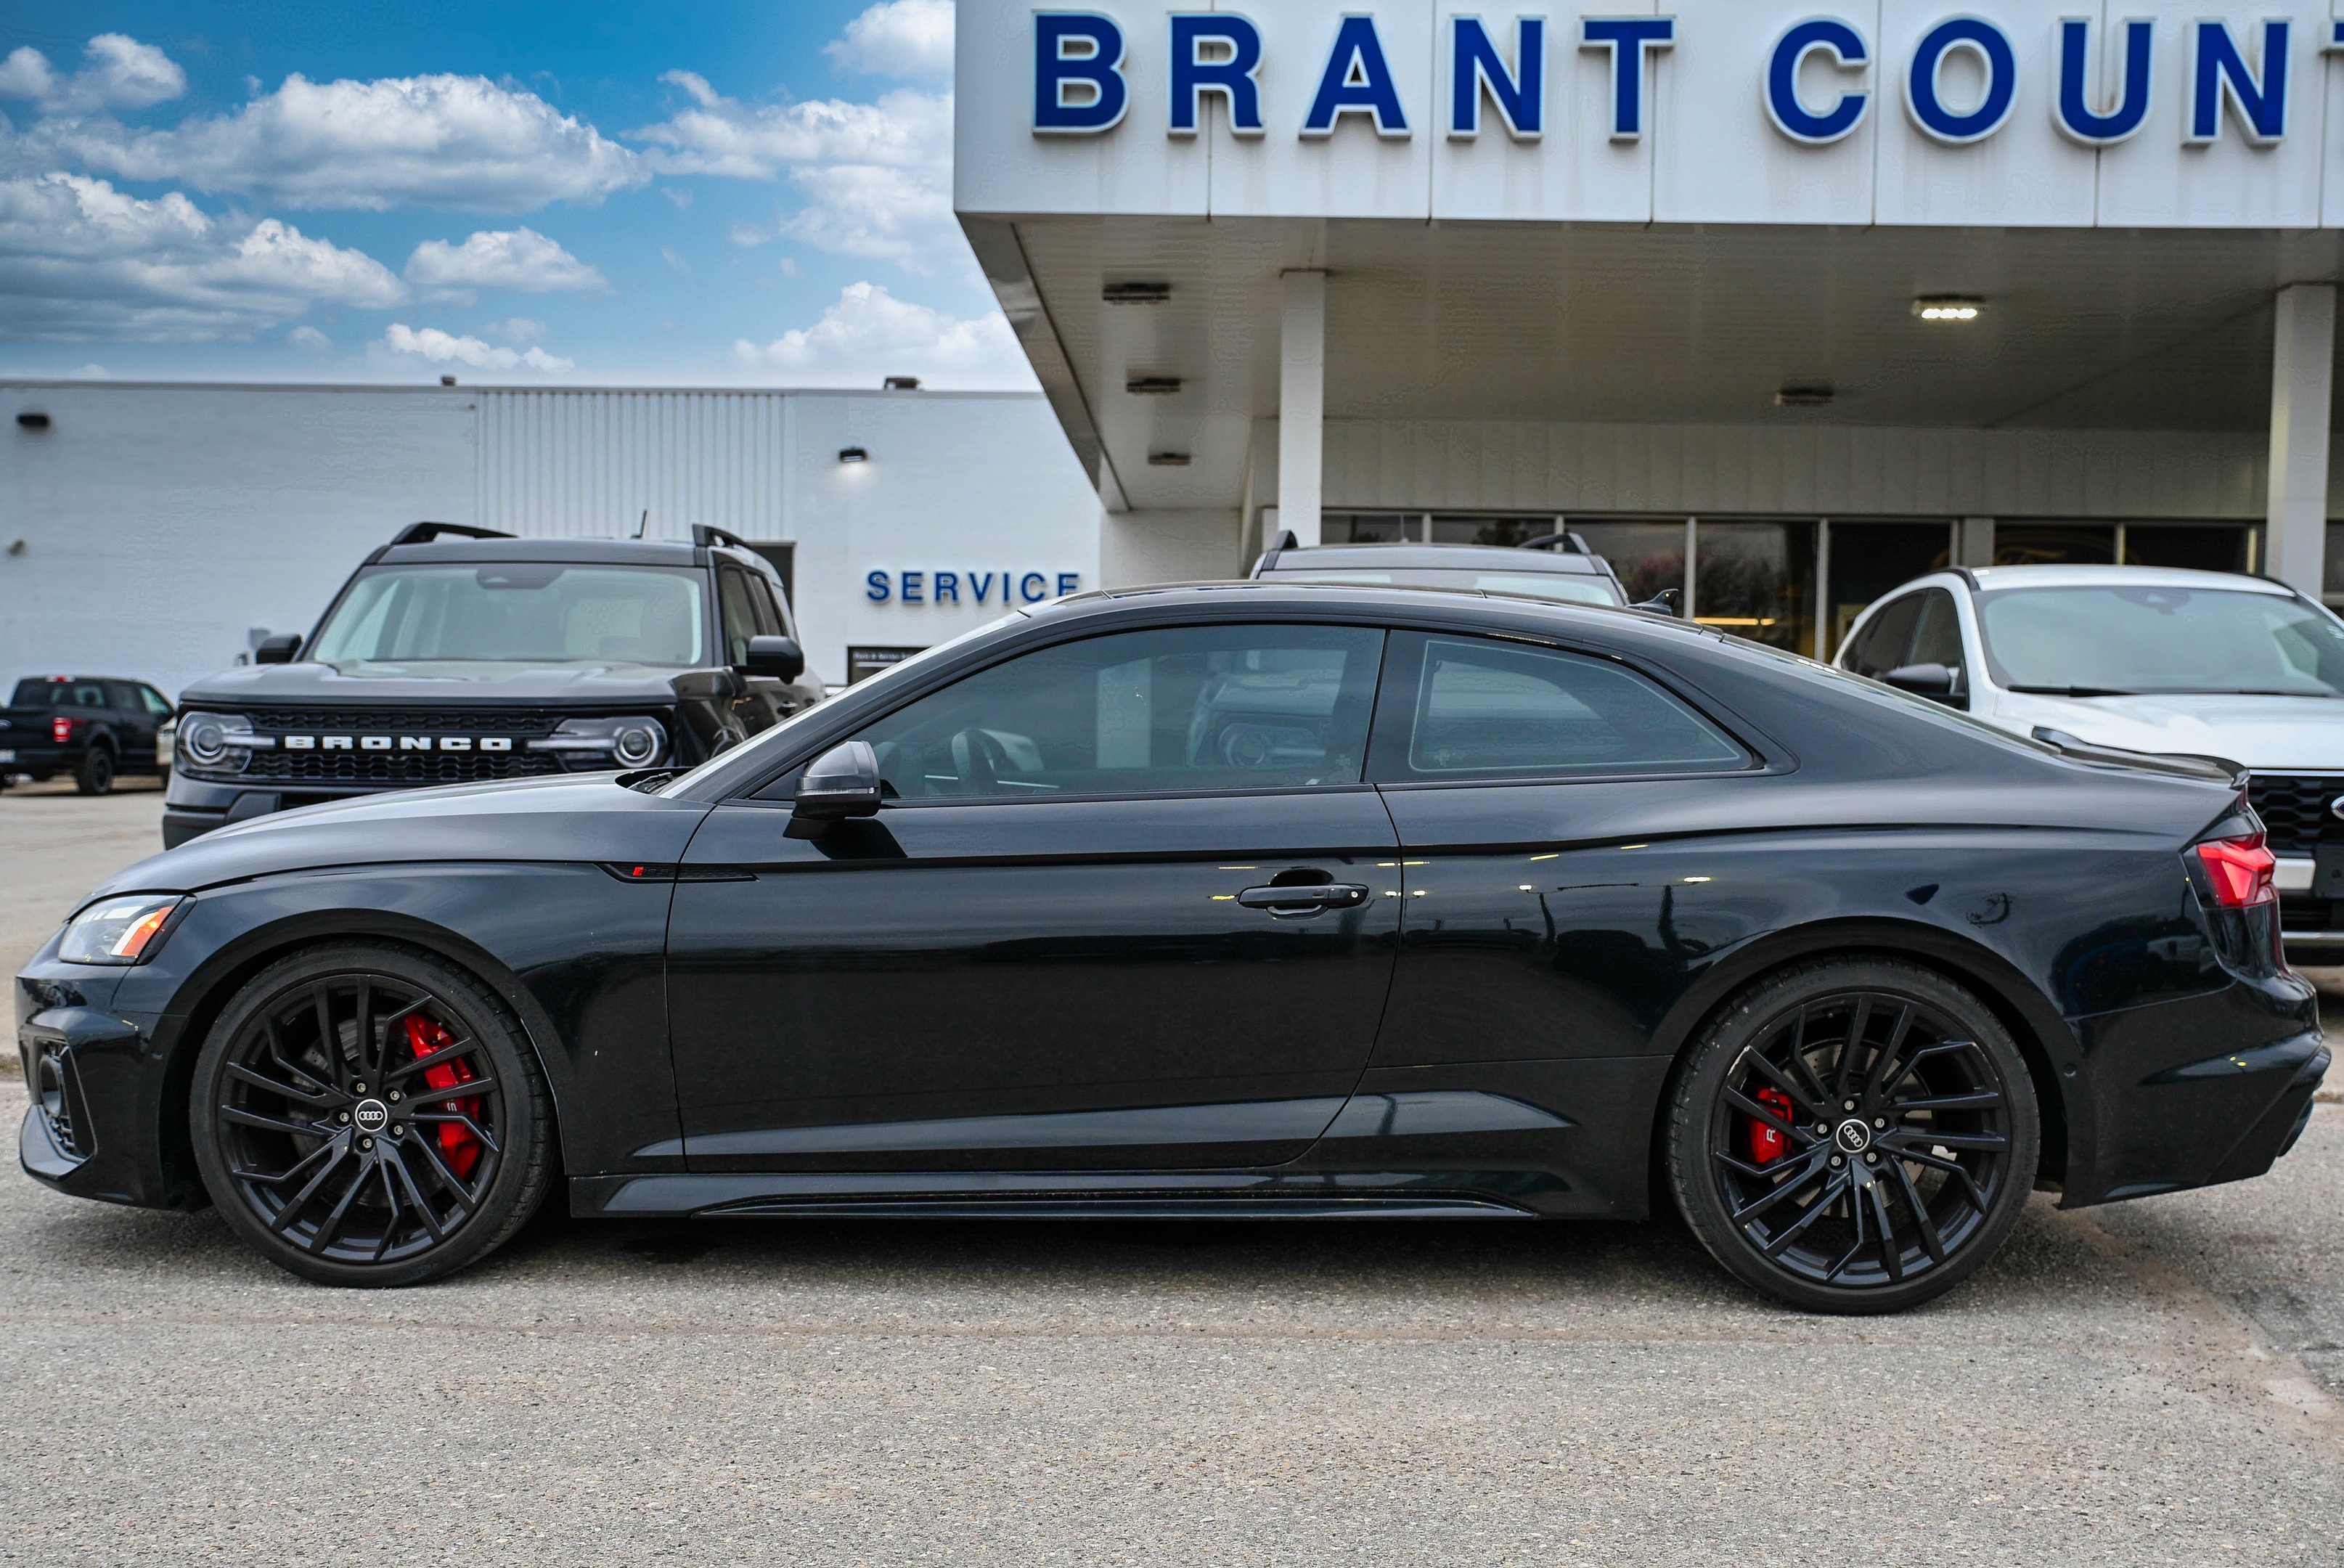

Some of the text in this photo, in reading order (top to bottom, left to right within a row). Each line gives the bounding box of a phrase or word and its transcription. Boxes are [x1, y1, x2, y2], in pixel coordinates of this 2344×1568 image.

[1032, 11, 2344, 142] BRANT COUN
[866, 571, 1080, 603] SERVICE
[285, 735, 513, 751] BRONCO
